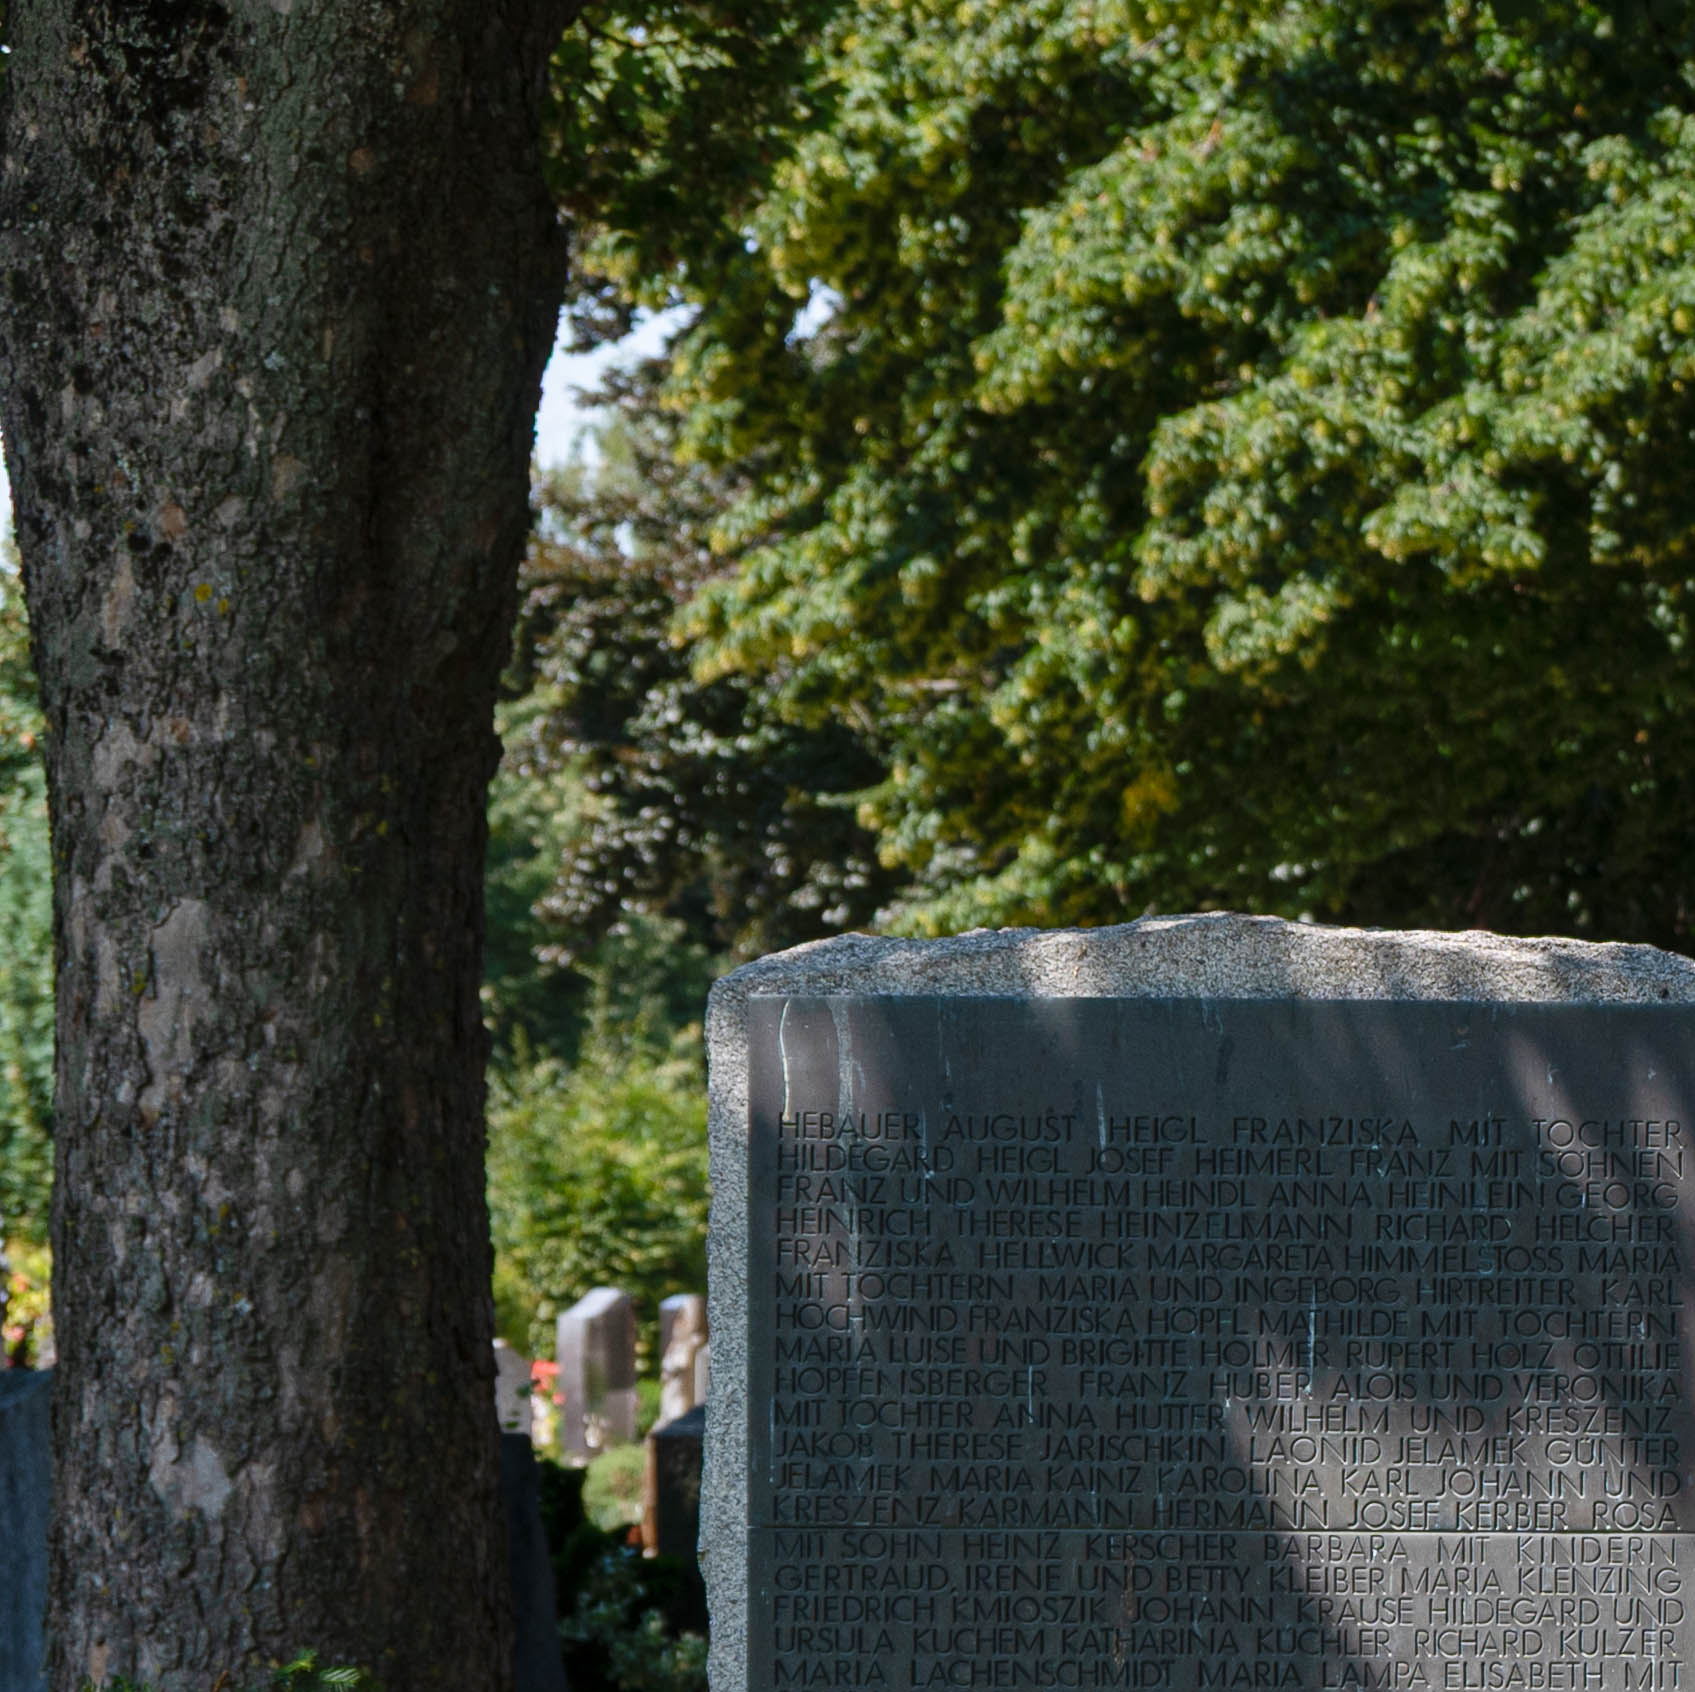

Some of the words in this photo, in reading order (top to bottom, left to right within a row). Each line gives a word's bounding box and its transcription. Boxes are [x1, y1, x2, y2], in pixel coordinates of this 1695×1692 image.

[777, 1112, 921, 1142] HEBAUER
[941, 1113, 1077, 1143] AUGUST
[1108, 1114, 1209, 1144] HEIGL
[1231, 1116, 1419, 1145] FRANZISKA
[1449, 1117, 1508, 1146] MIT
[1530, 1118, 1684, 1147] TOCHTER
[775, 1207, 932, 1236] HEINRICH
[953, 1208, 1082, 1237] THERESE
[1099, 1210, 1354, 1239] HEINZELMANN
[1374, 1212, 1513, 1241] RICHARD
